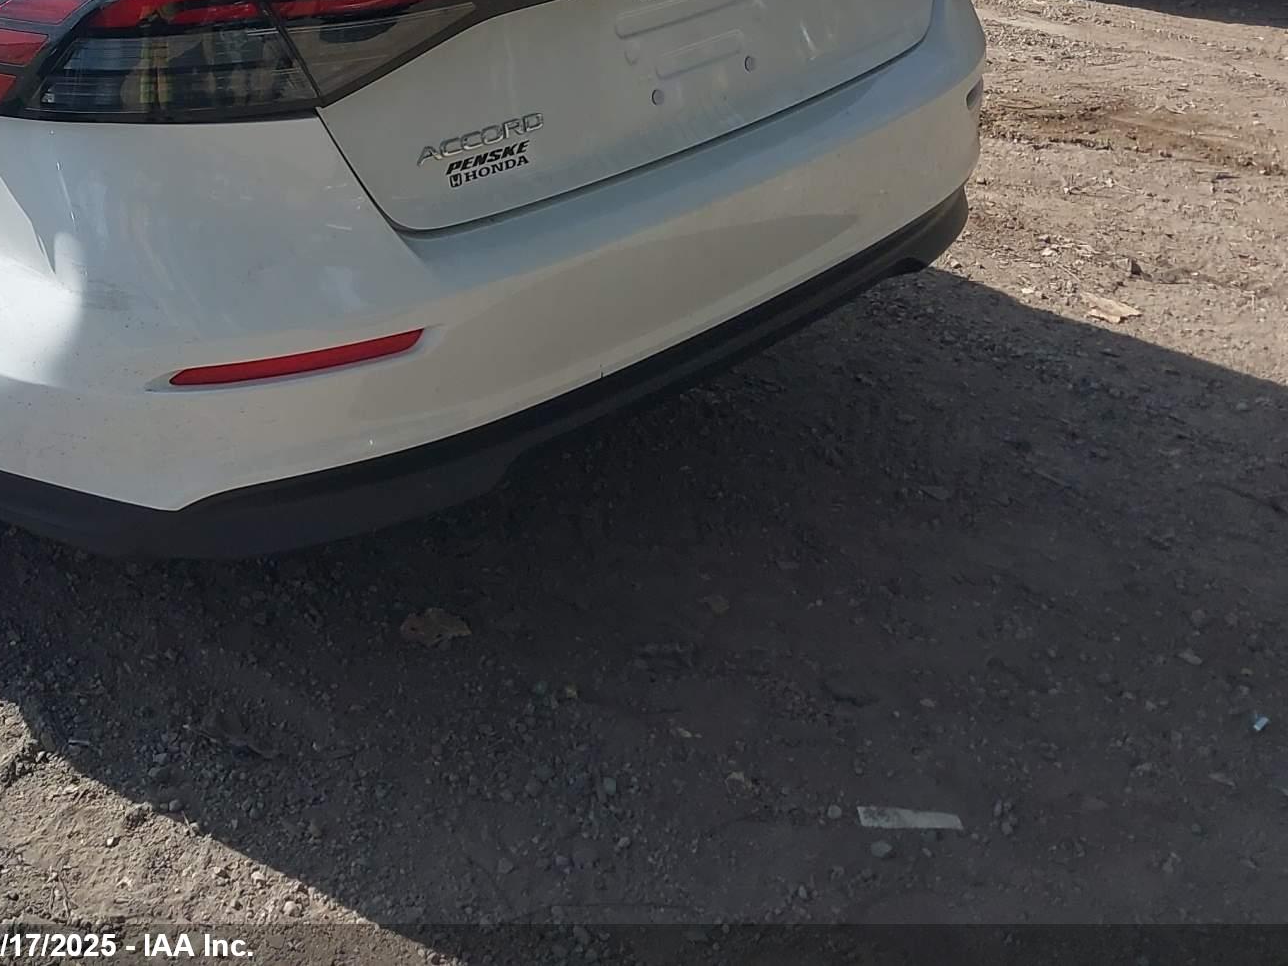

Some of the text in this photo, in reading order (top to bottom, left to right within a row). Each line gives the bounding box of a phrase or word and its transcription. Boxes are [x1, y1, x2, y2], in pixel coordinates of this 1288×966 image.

[416, 112, 544, 167] ACCORD
[446, 139, 530, 176] PENSKE
[465, 155, 529, 182] HONDA
